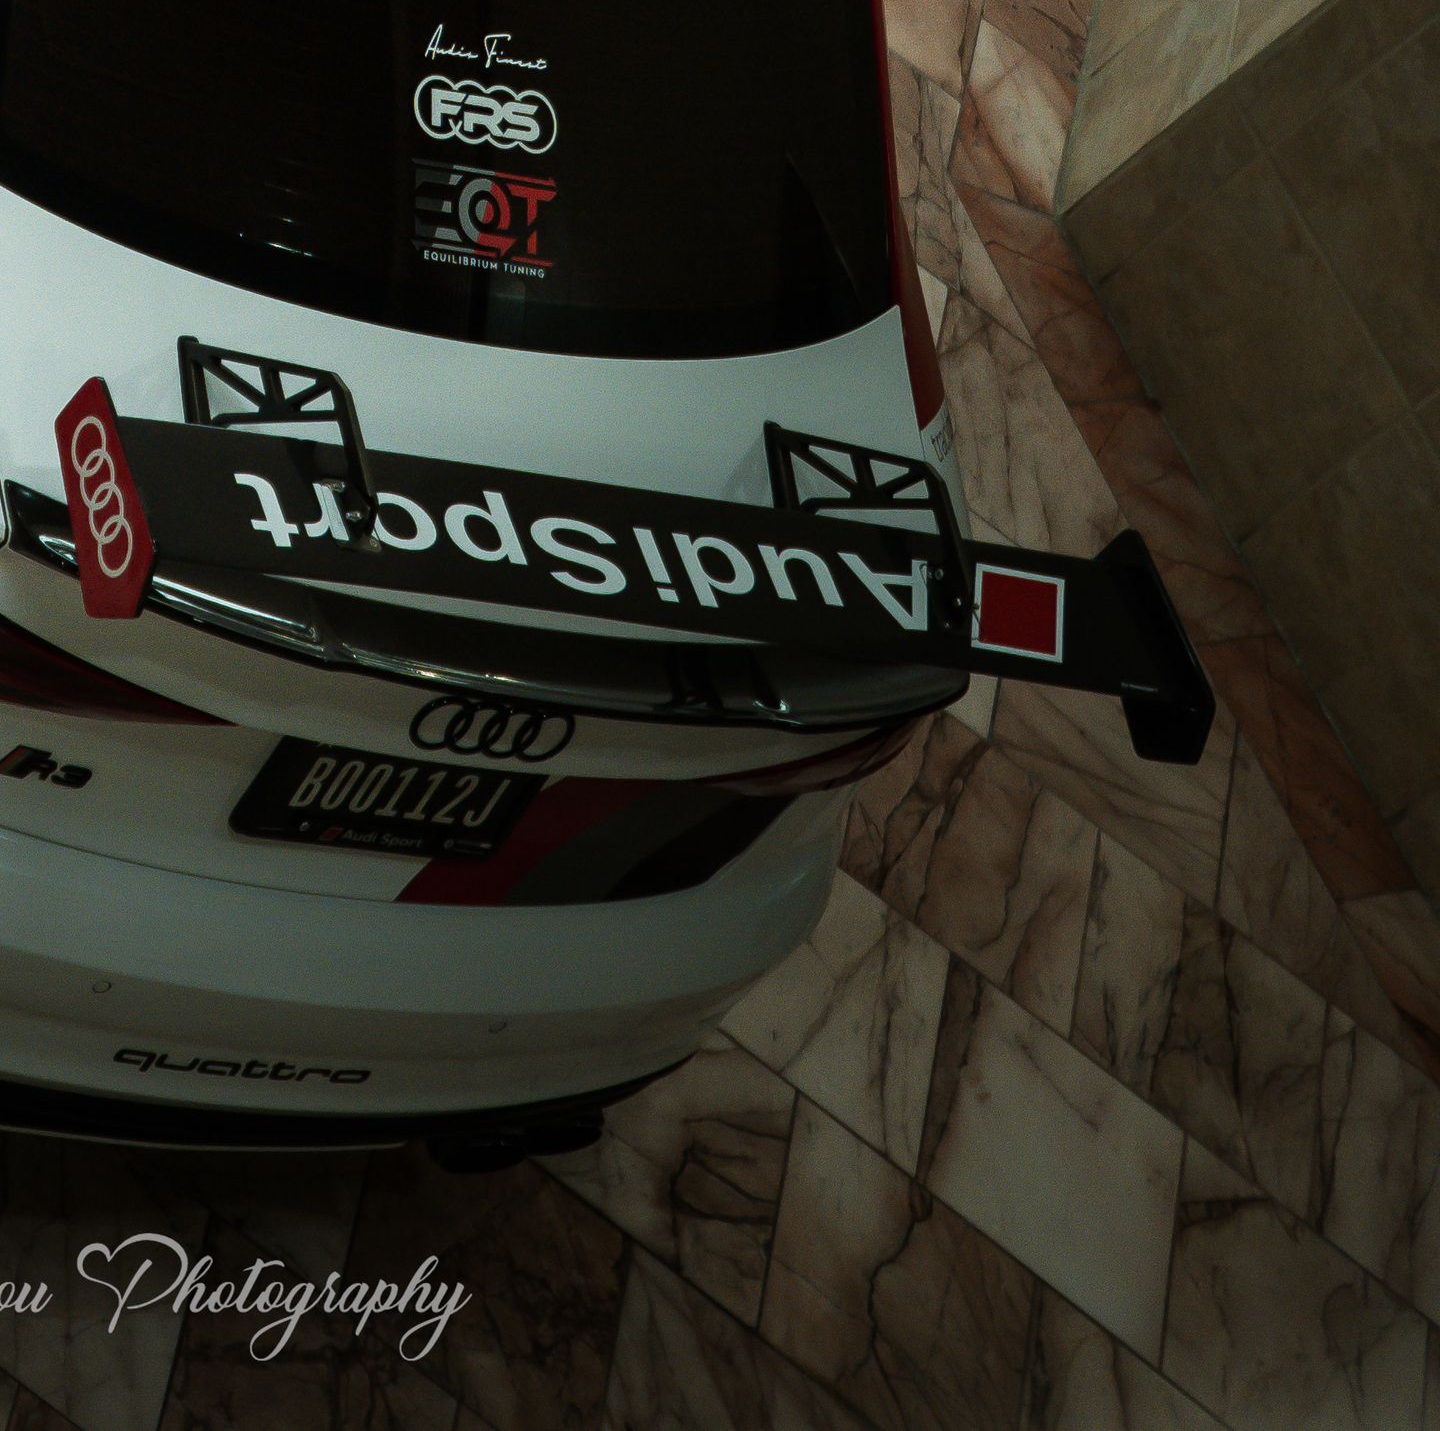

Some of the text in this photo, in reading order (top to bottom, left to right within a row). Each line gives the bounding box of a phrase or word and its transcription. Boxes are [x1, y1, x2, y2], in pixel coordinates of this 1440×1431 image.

[430, 88, 541, 143] FRS
[423, 249, 545, 279] EQUILIBRIUM TUNING
[340, 828, 425, 849] Audi Sport
[113, 1048, 372, 1084] quattro
